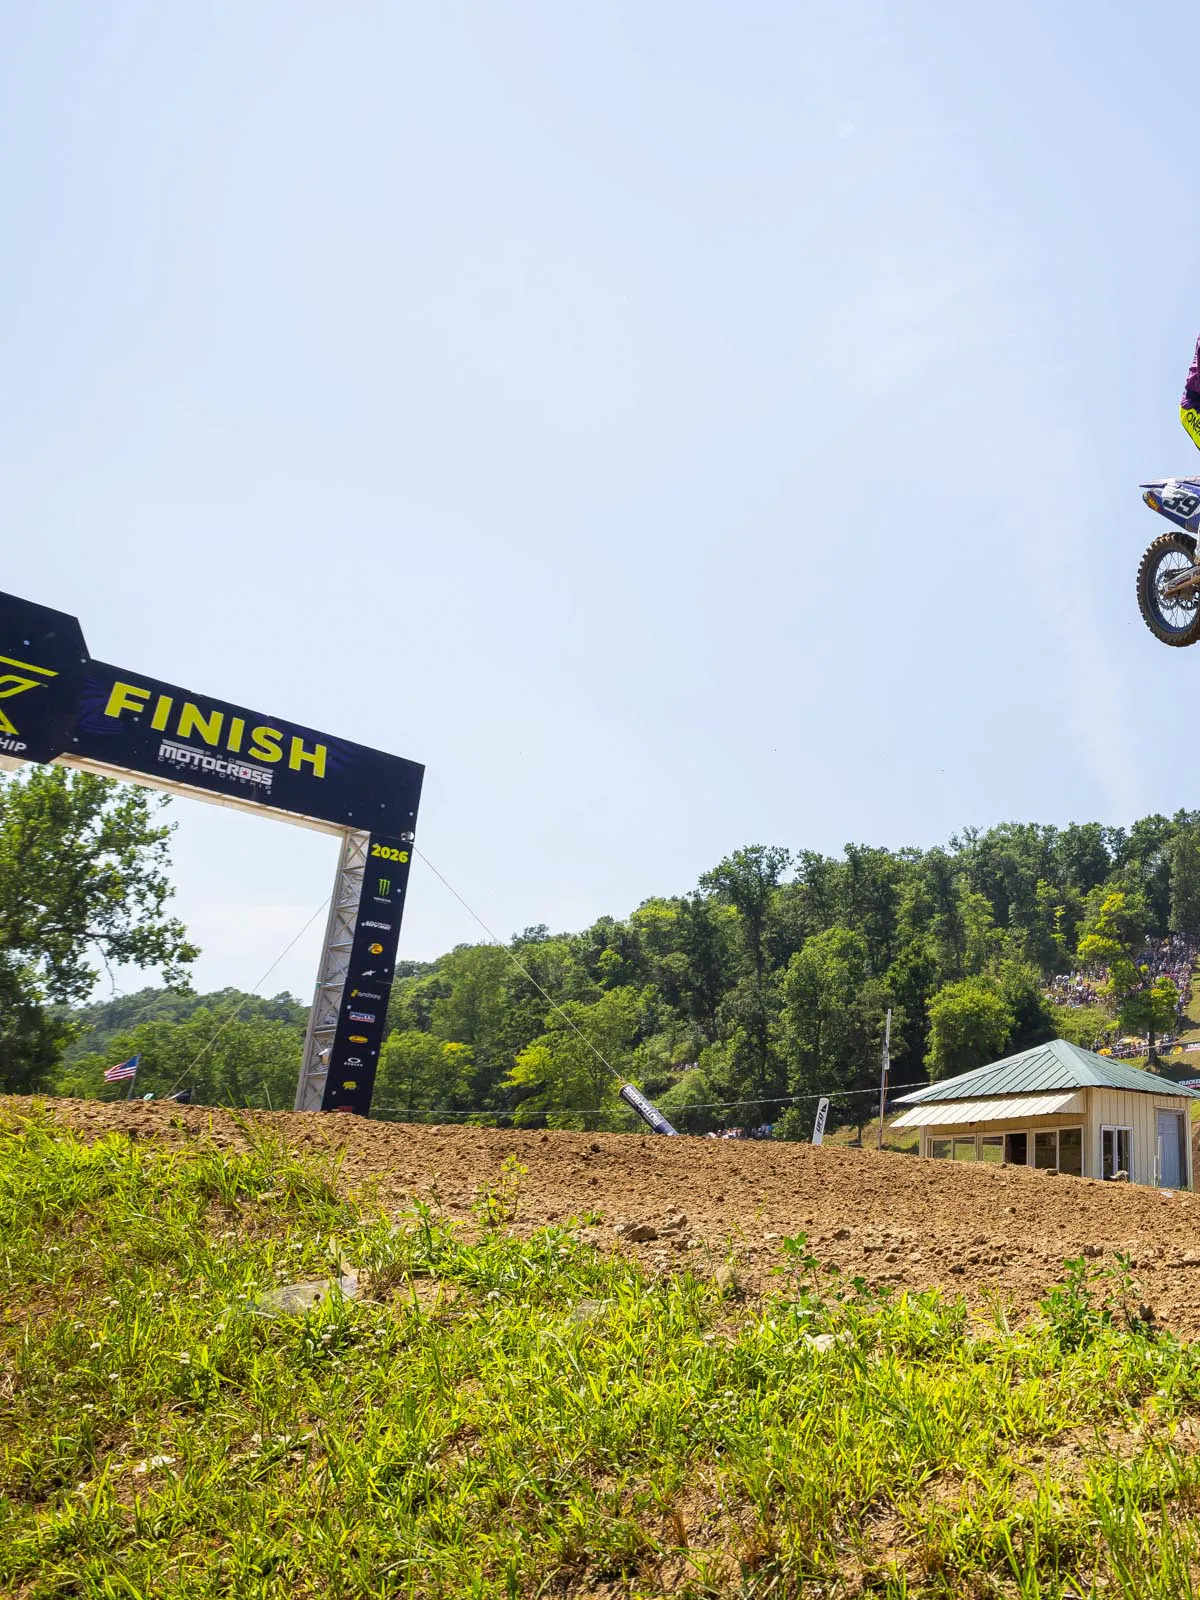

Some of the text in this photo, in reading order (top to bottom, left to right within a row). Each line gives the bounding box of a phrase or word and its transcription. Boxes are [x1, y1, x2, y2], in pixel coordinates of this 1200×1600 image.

[1163, 490, 1200, 517] 39
[104, 681, 328, 779] FINISH
[157, 756, 272, 790] CHAMPIONSHIP
[158, 744, 273, 786] MOTOCROSS
[371, 843, 409, 864] 2026
